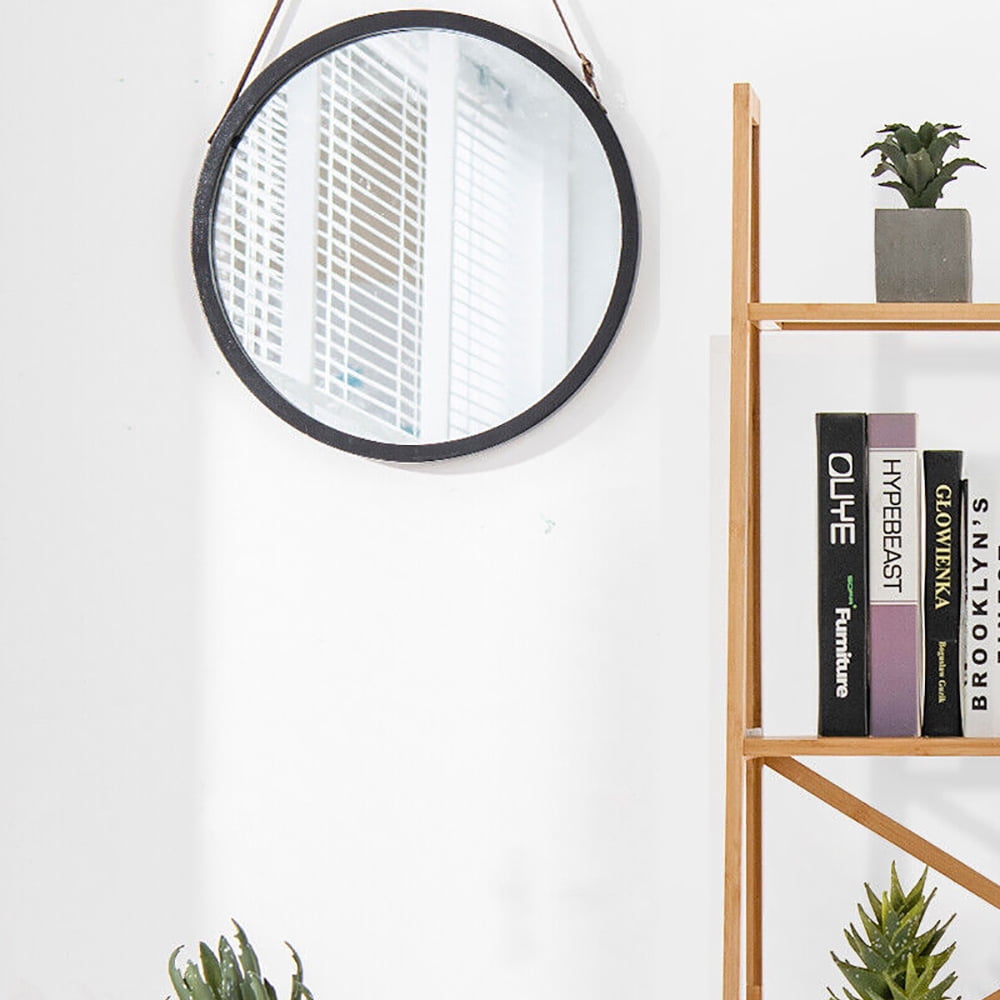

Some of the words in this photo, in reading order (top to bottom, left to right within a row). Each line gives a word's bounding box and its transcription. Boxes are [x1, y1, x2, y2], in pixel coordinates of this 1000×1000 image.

[882, 459, 903, 593] HYPEBEAST
[835, 607, 852, 699] Furniture
[972, 497, 989, 711] BROOKLYN'S
